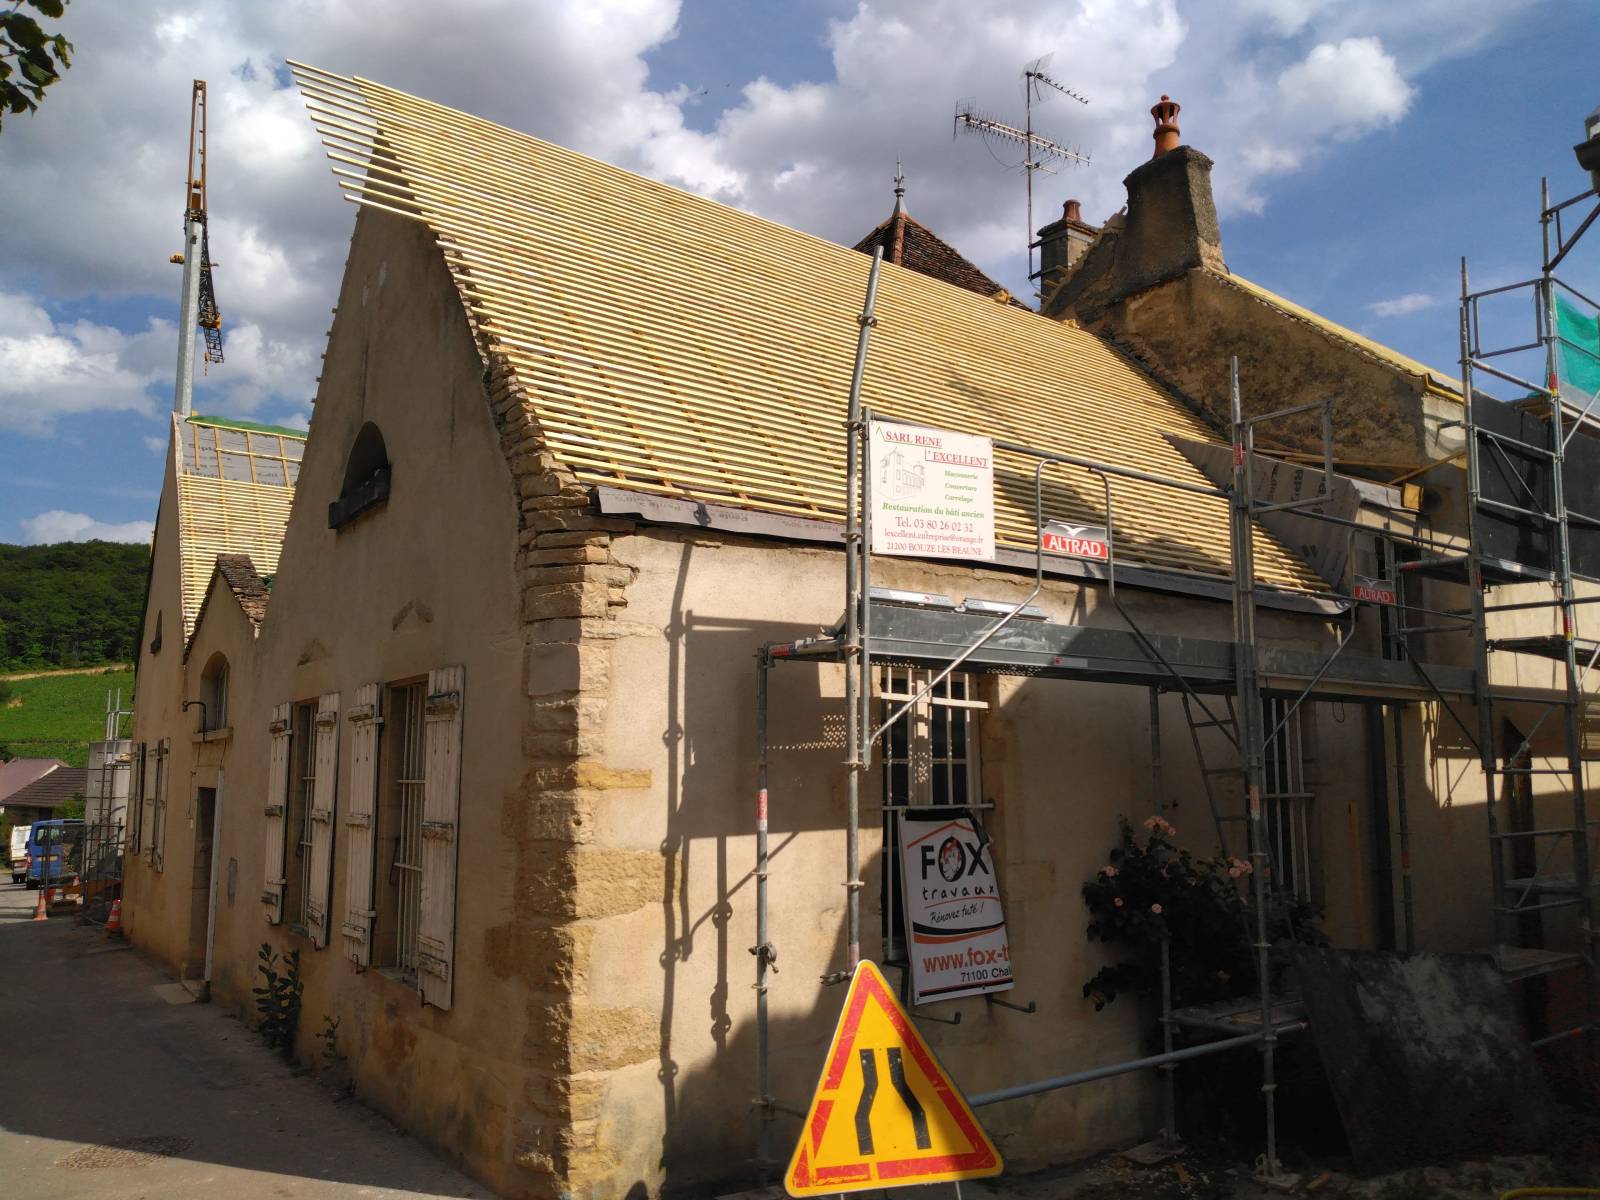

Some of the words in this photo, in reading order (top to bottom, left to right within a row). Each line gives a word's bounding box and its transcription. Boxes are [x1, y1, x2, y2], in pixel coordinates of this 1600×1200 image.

[886, 431, 913, 442] SARL
[882, 502, 932, 514] Restauration
[934, 506, 944, 515] du
[961, 510, 985, 519] ancien
[913, 518, 924, 529] 03
[926, 520, 938, 530] 80
[940, 521, 950, 530] 26
[951, 522, 961, 531] 02
[964, 523, 974, 532] 32
[887, 542, 907, 551] 21200
[909, 543, 935, 553] BOUZE
[937, 545, 950, 553] LES
[952, 546, 983, 556] BEAUNE
[1048, 535, 1101, 556] ALTRAD
[1359, 587, 1390, 602] ALTRAD
[921, 836, 990, 882] FOX
[922, 884, 994, 900] travaux
[930, 910, 960, 924] Rénovez
[961, 968, 988, 982] 71100
